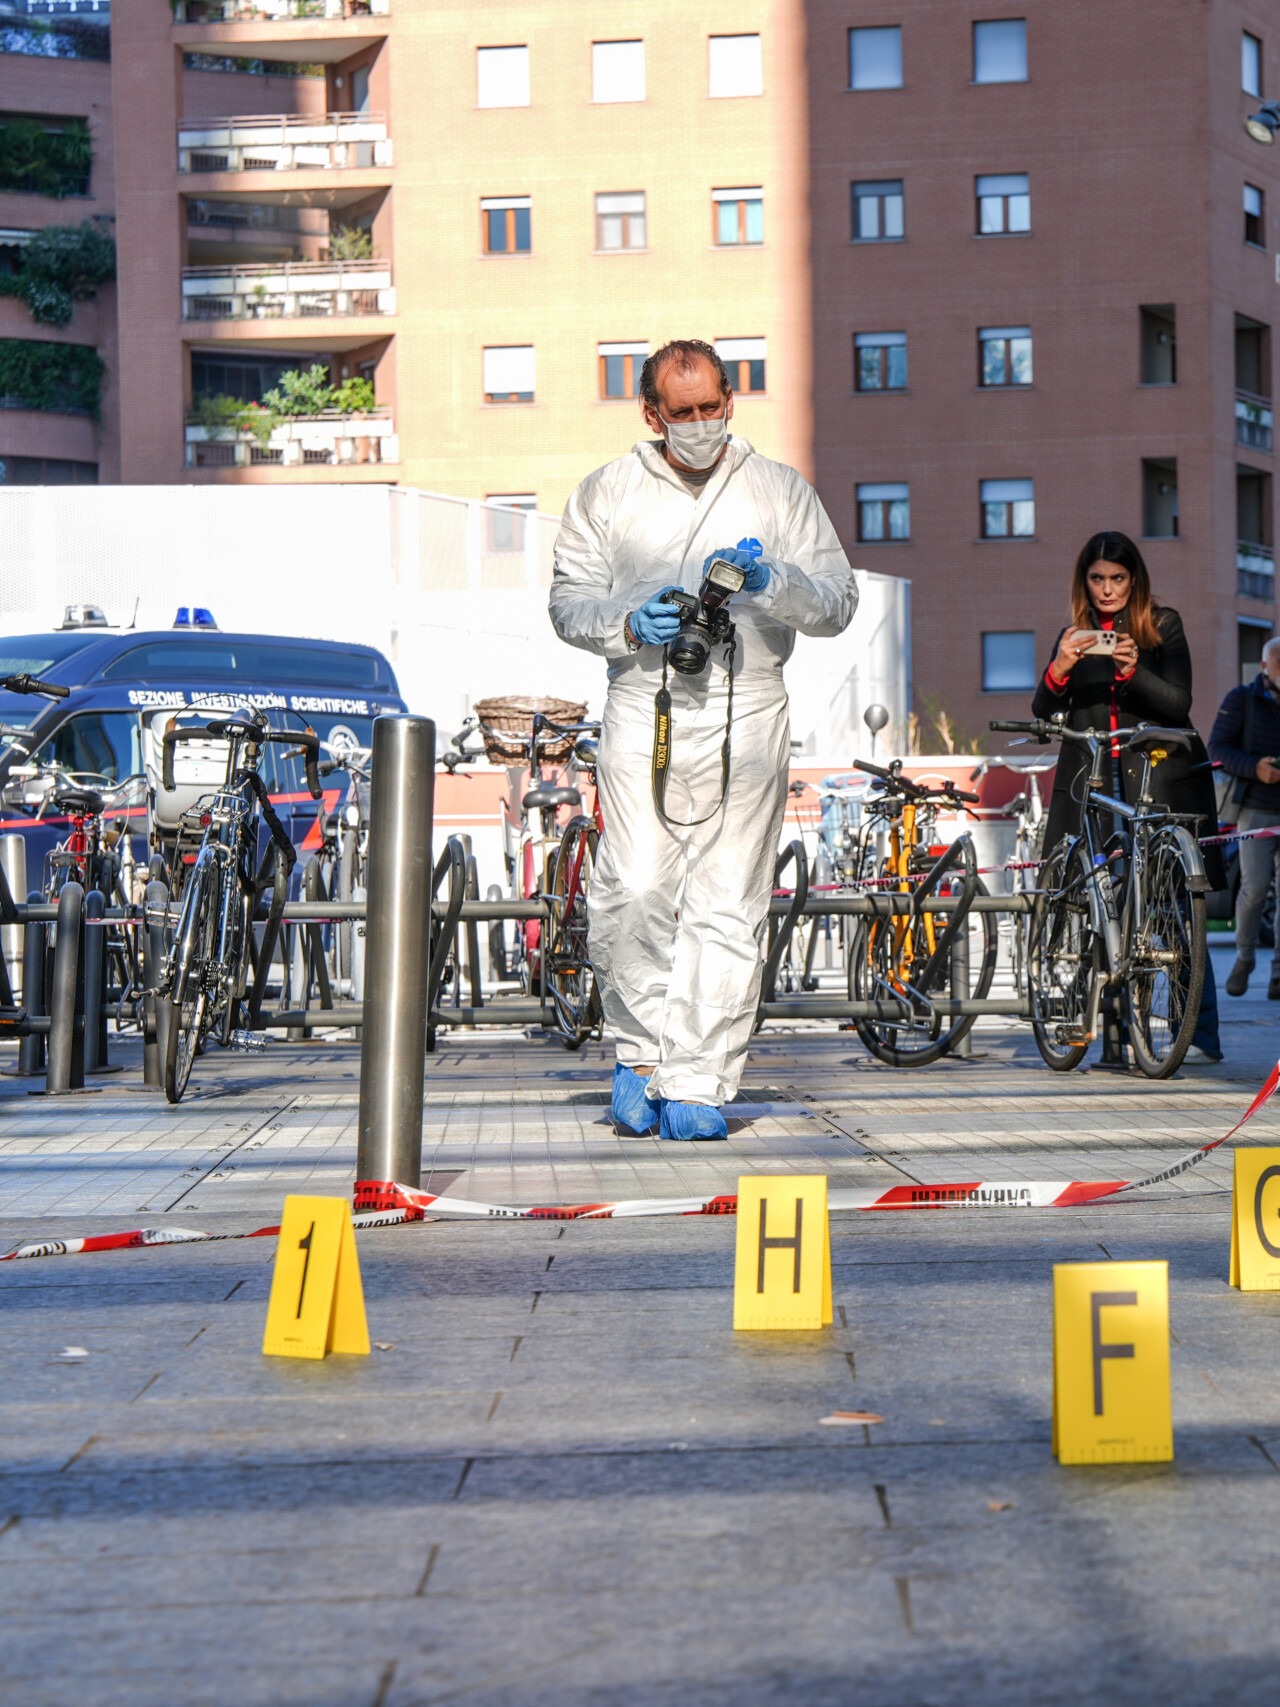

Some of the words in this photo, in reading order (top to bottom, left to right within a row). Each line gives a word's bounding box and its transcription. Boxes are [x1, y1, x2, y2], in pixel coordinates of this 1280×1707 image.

[128, 690, 186, 706] SEZIONE
[191, 691, 288, 709] INVESTIGAZIONI
[290, 695, 370, 715] SCIENTIFICHE
[658, 715, 668, 743] Nikon
[296, 1220, 315, 1320] 1
[756, 1197, 804, 1294] H
[1091, 1291, 1138, 1416] F
